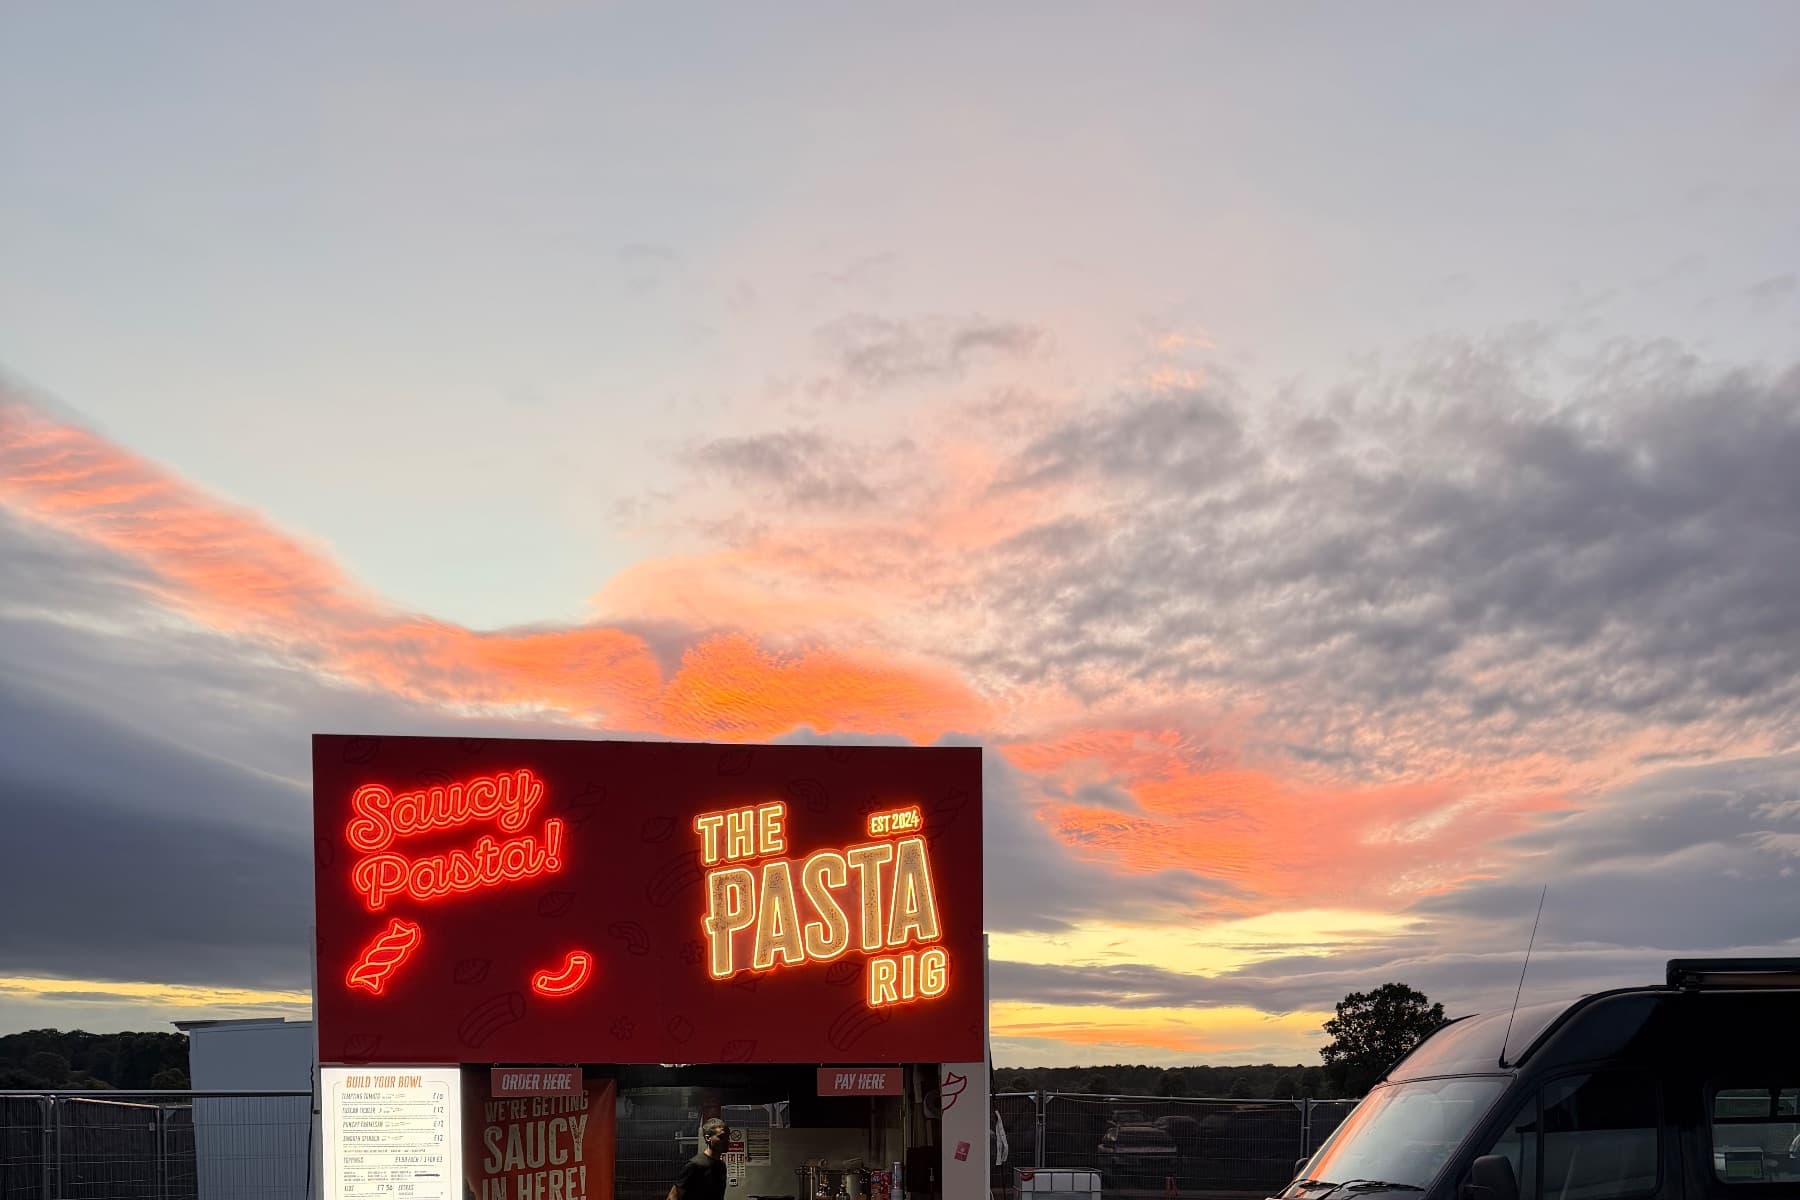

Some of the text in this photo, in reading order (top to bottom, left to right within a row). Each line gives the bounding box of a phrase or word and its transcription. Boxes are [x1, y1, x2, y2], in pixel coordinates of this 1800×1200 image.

[348, 771, 542, 851] Saucy
[697, 804, 783, 863] THE
[870, 810, 919, 833] EST 2024
[355, 820, 561, 907] Pasta!
[705, 838, 940, 977] PASTA
[871, 949, 946, 1004] RIG
[346, 1075, 423, 1088] BUILD YOUR BOWL
[502, 1074, 573, 1090] ORDER HERE
[834, 1073, 886, 1090] PAY HERE
[484, 1097, 528, 1122] WE'RE
[484, 1114, 588, 1174] SAUCY
